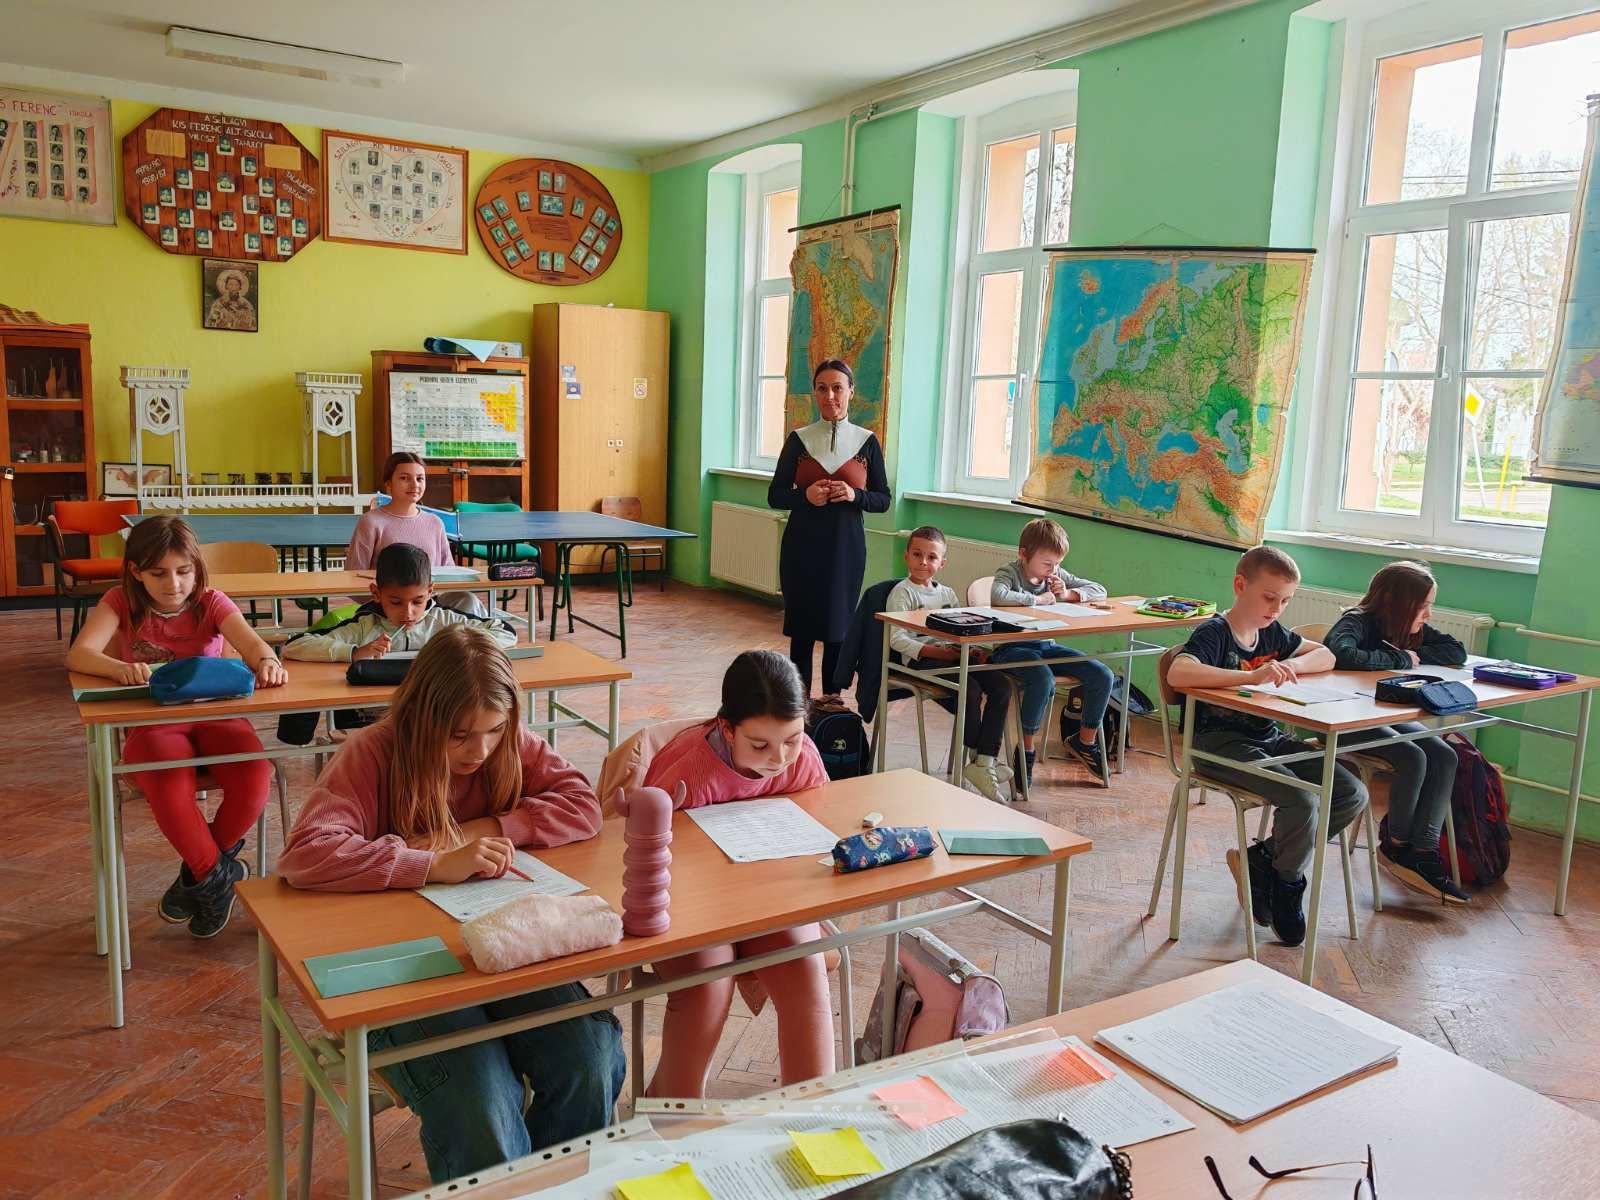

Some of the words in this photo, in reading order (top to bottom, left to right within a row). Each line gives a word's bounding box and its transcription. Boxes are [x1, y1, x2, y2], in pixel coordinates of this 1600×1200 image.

[12, 100, 57, 116] FERENC
[172, 119, 187, 129] KIS
[189, 121, 222, 134] FERENC
[244, 129, 273, 140] ISKOLA
